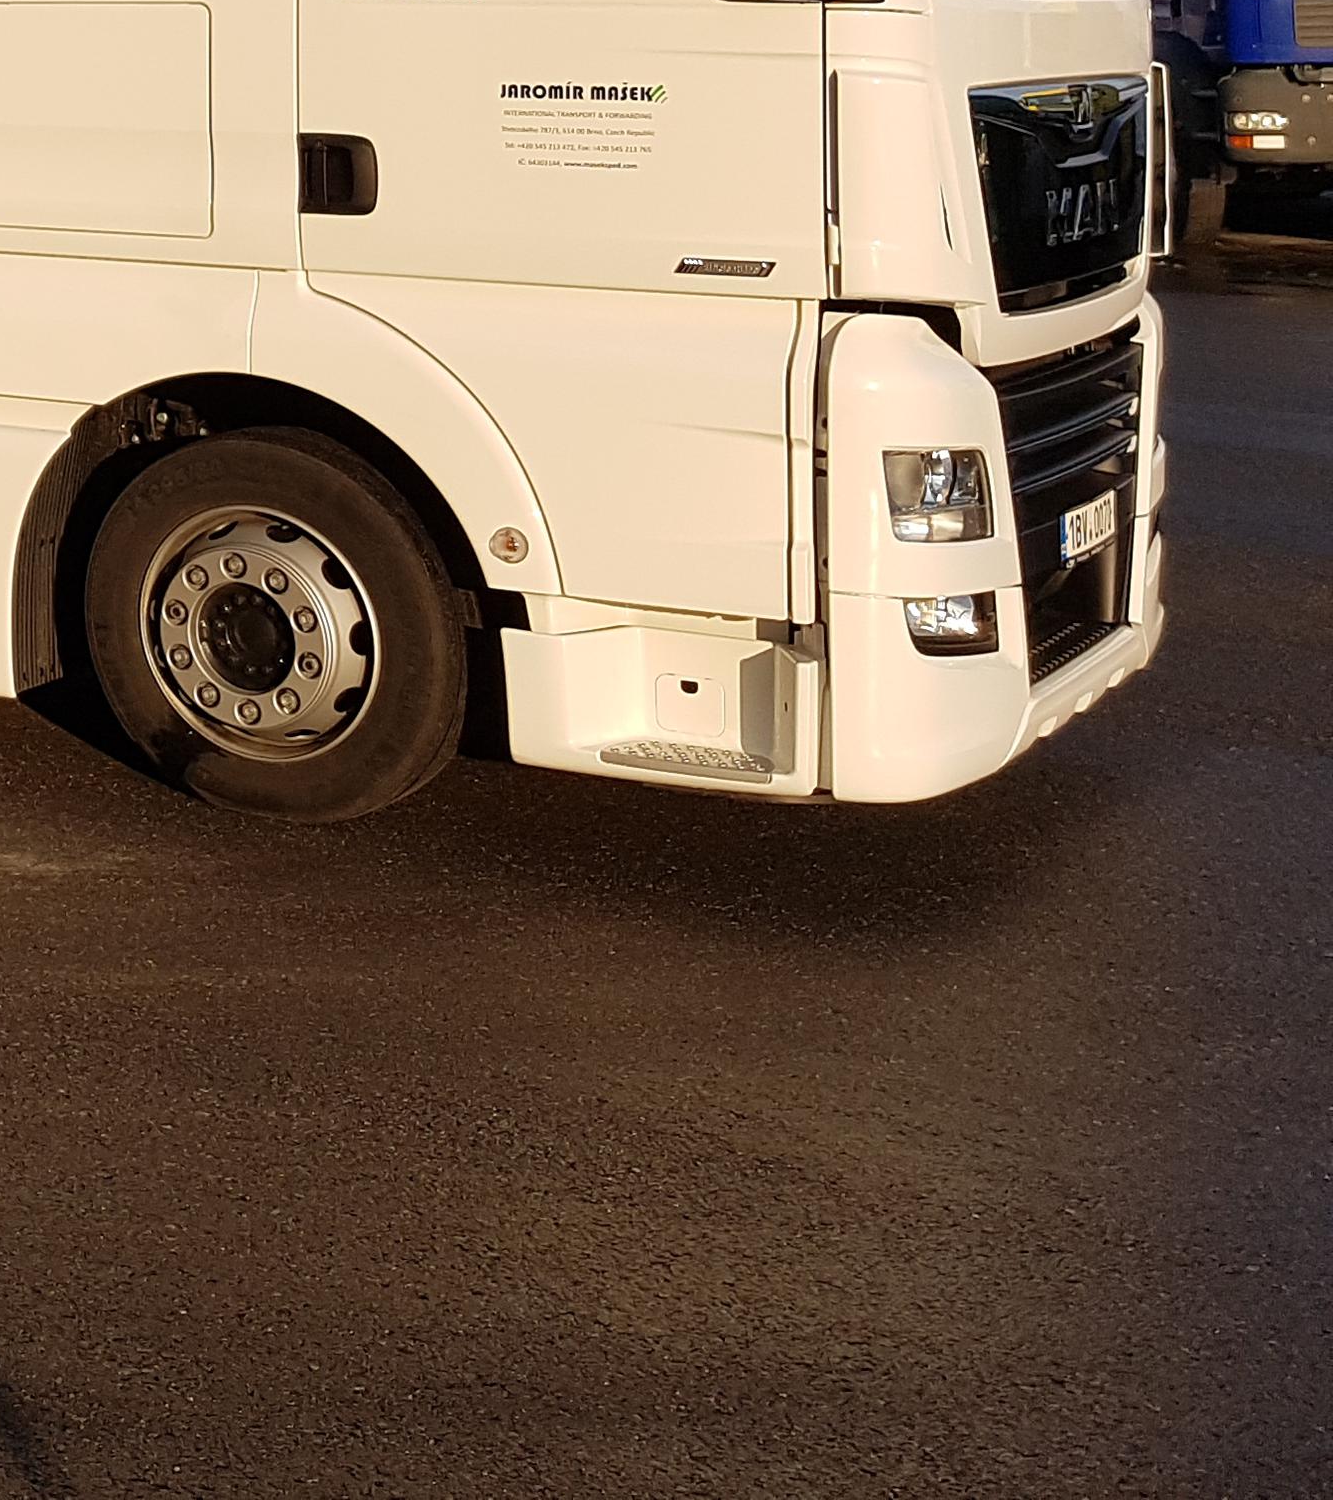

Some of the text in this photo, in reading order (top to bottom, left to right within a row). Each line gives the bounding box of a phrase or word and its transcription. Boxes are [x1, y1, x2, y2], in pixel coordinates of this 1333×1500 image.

[500, 81, 653, 102] JAROMÍR MAŠEK
[1045, 178, 1120, 247] MAN
